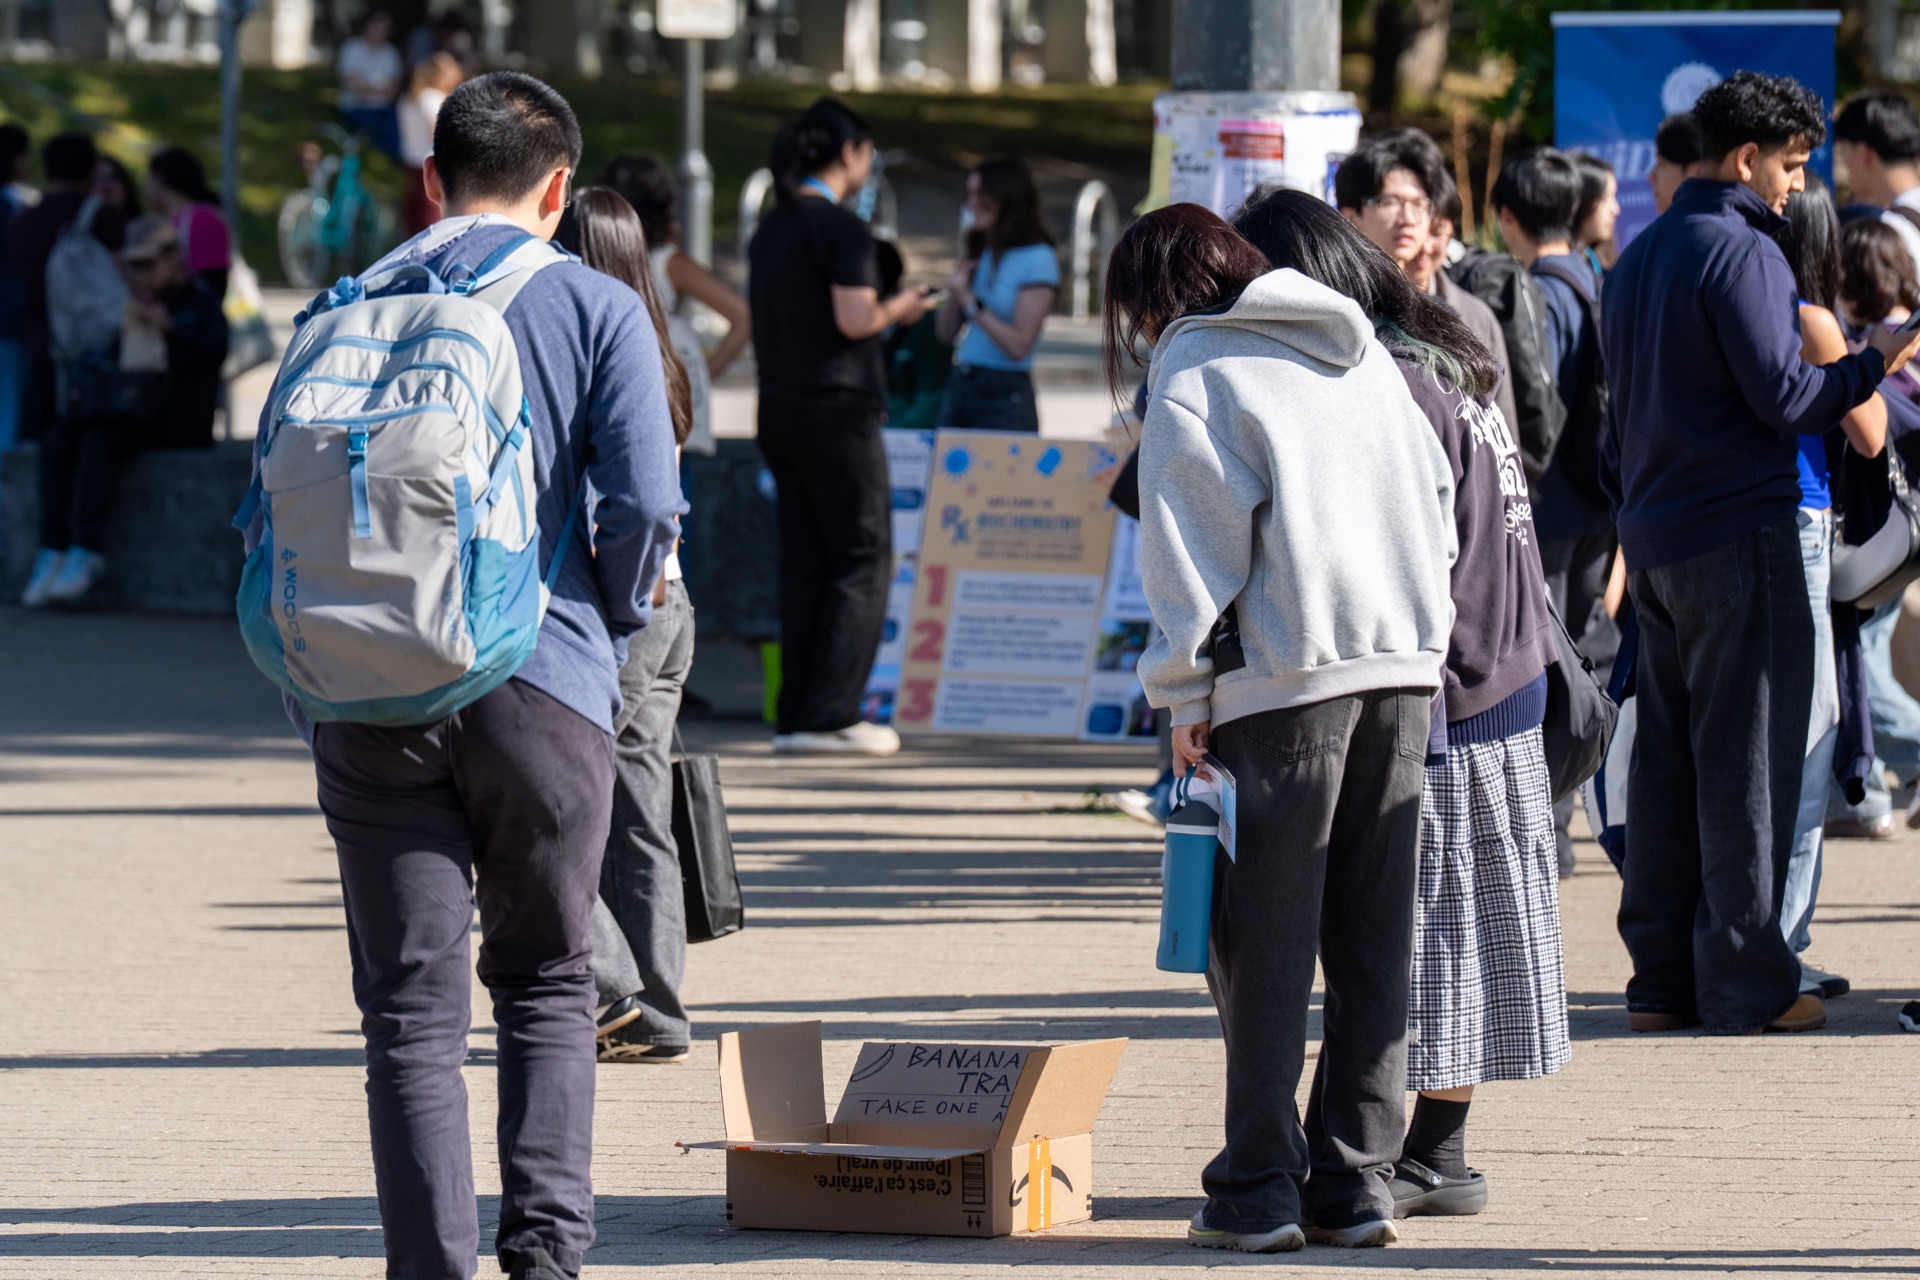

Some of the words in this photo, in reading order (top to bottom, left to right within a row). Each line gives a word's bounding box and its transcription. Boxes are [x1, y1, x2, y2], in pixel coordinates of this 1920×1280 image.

[926, 564, 947, 608] 1
[284, 566, 306, 653] WOODS
[910, 619, 945, 663] 2
[900, 678, 937, 722] 3
[907, 1045, 1021, 1069] BANANA
[859, 1098, 927, 1115] TAKE
[936, 1101, 979, 1115] ONE
